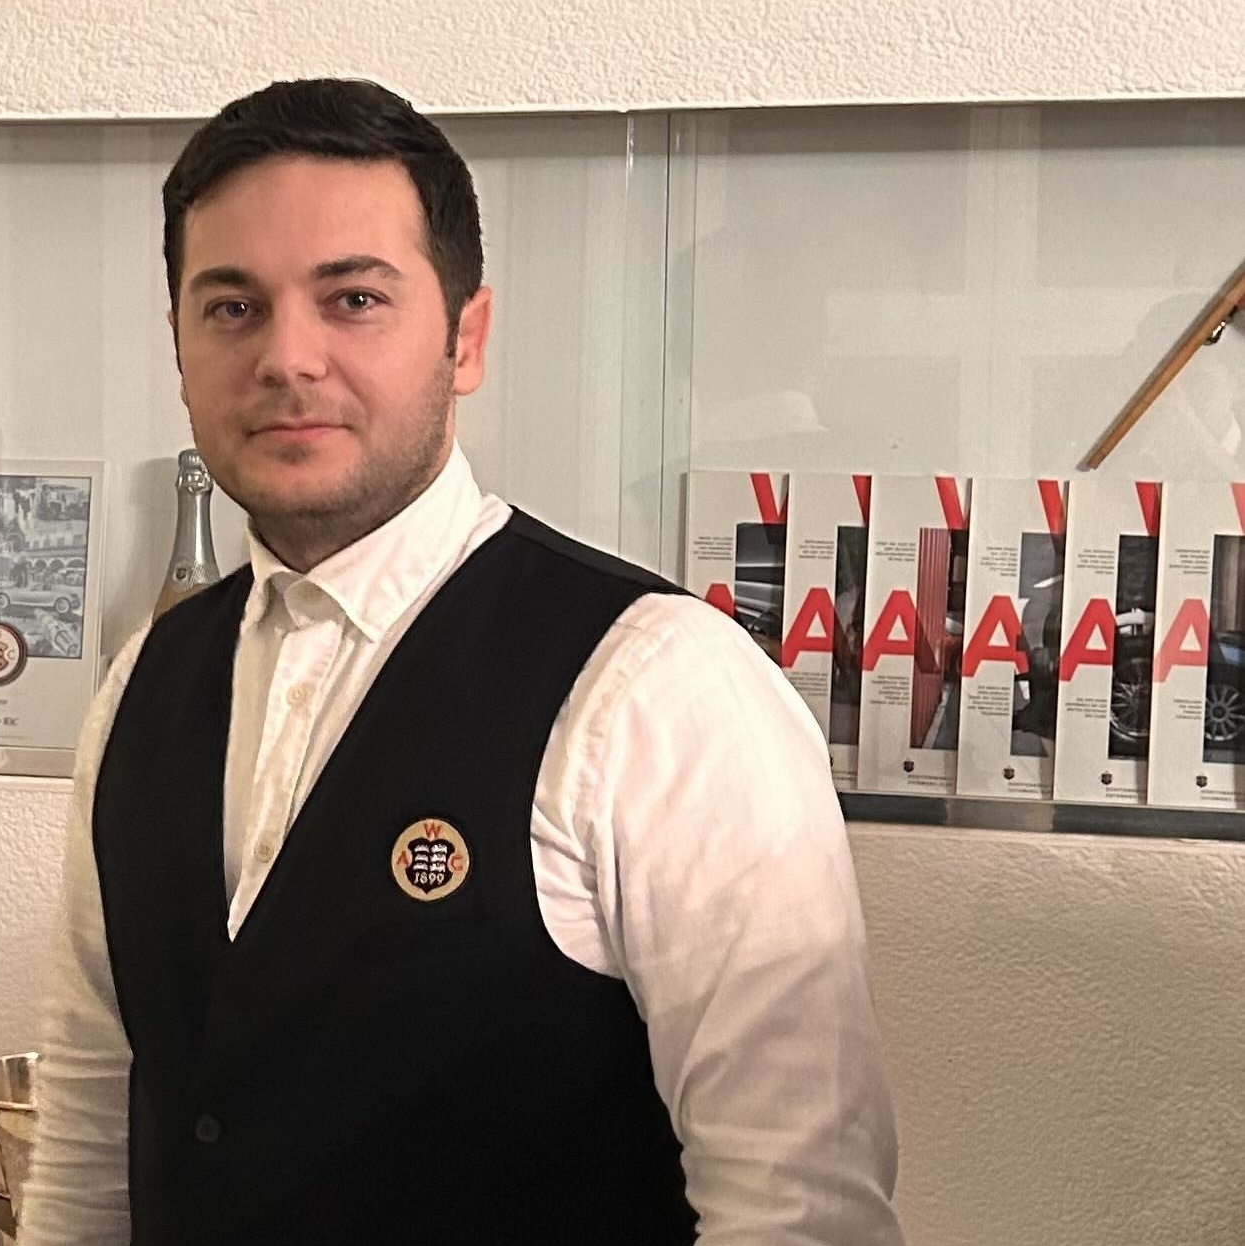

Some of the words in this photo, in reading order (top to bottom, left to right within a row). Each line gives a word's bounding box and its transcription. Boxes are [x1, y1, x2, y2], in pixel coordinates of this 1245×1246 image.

[781, 587, 834, 669] A
[862, 590, 916, 672] A
[961, 595, 1029, 678] A
[1059, 598, 1117, 682] A
[1153, 598, 1210, 683] A
[424, 821, 442, 839] W
[414, 872, 445, 885] 1899
